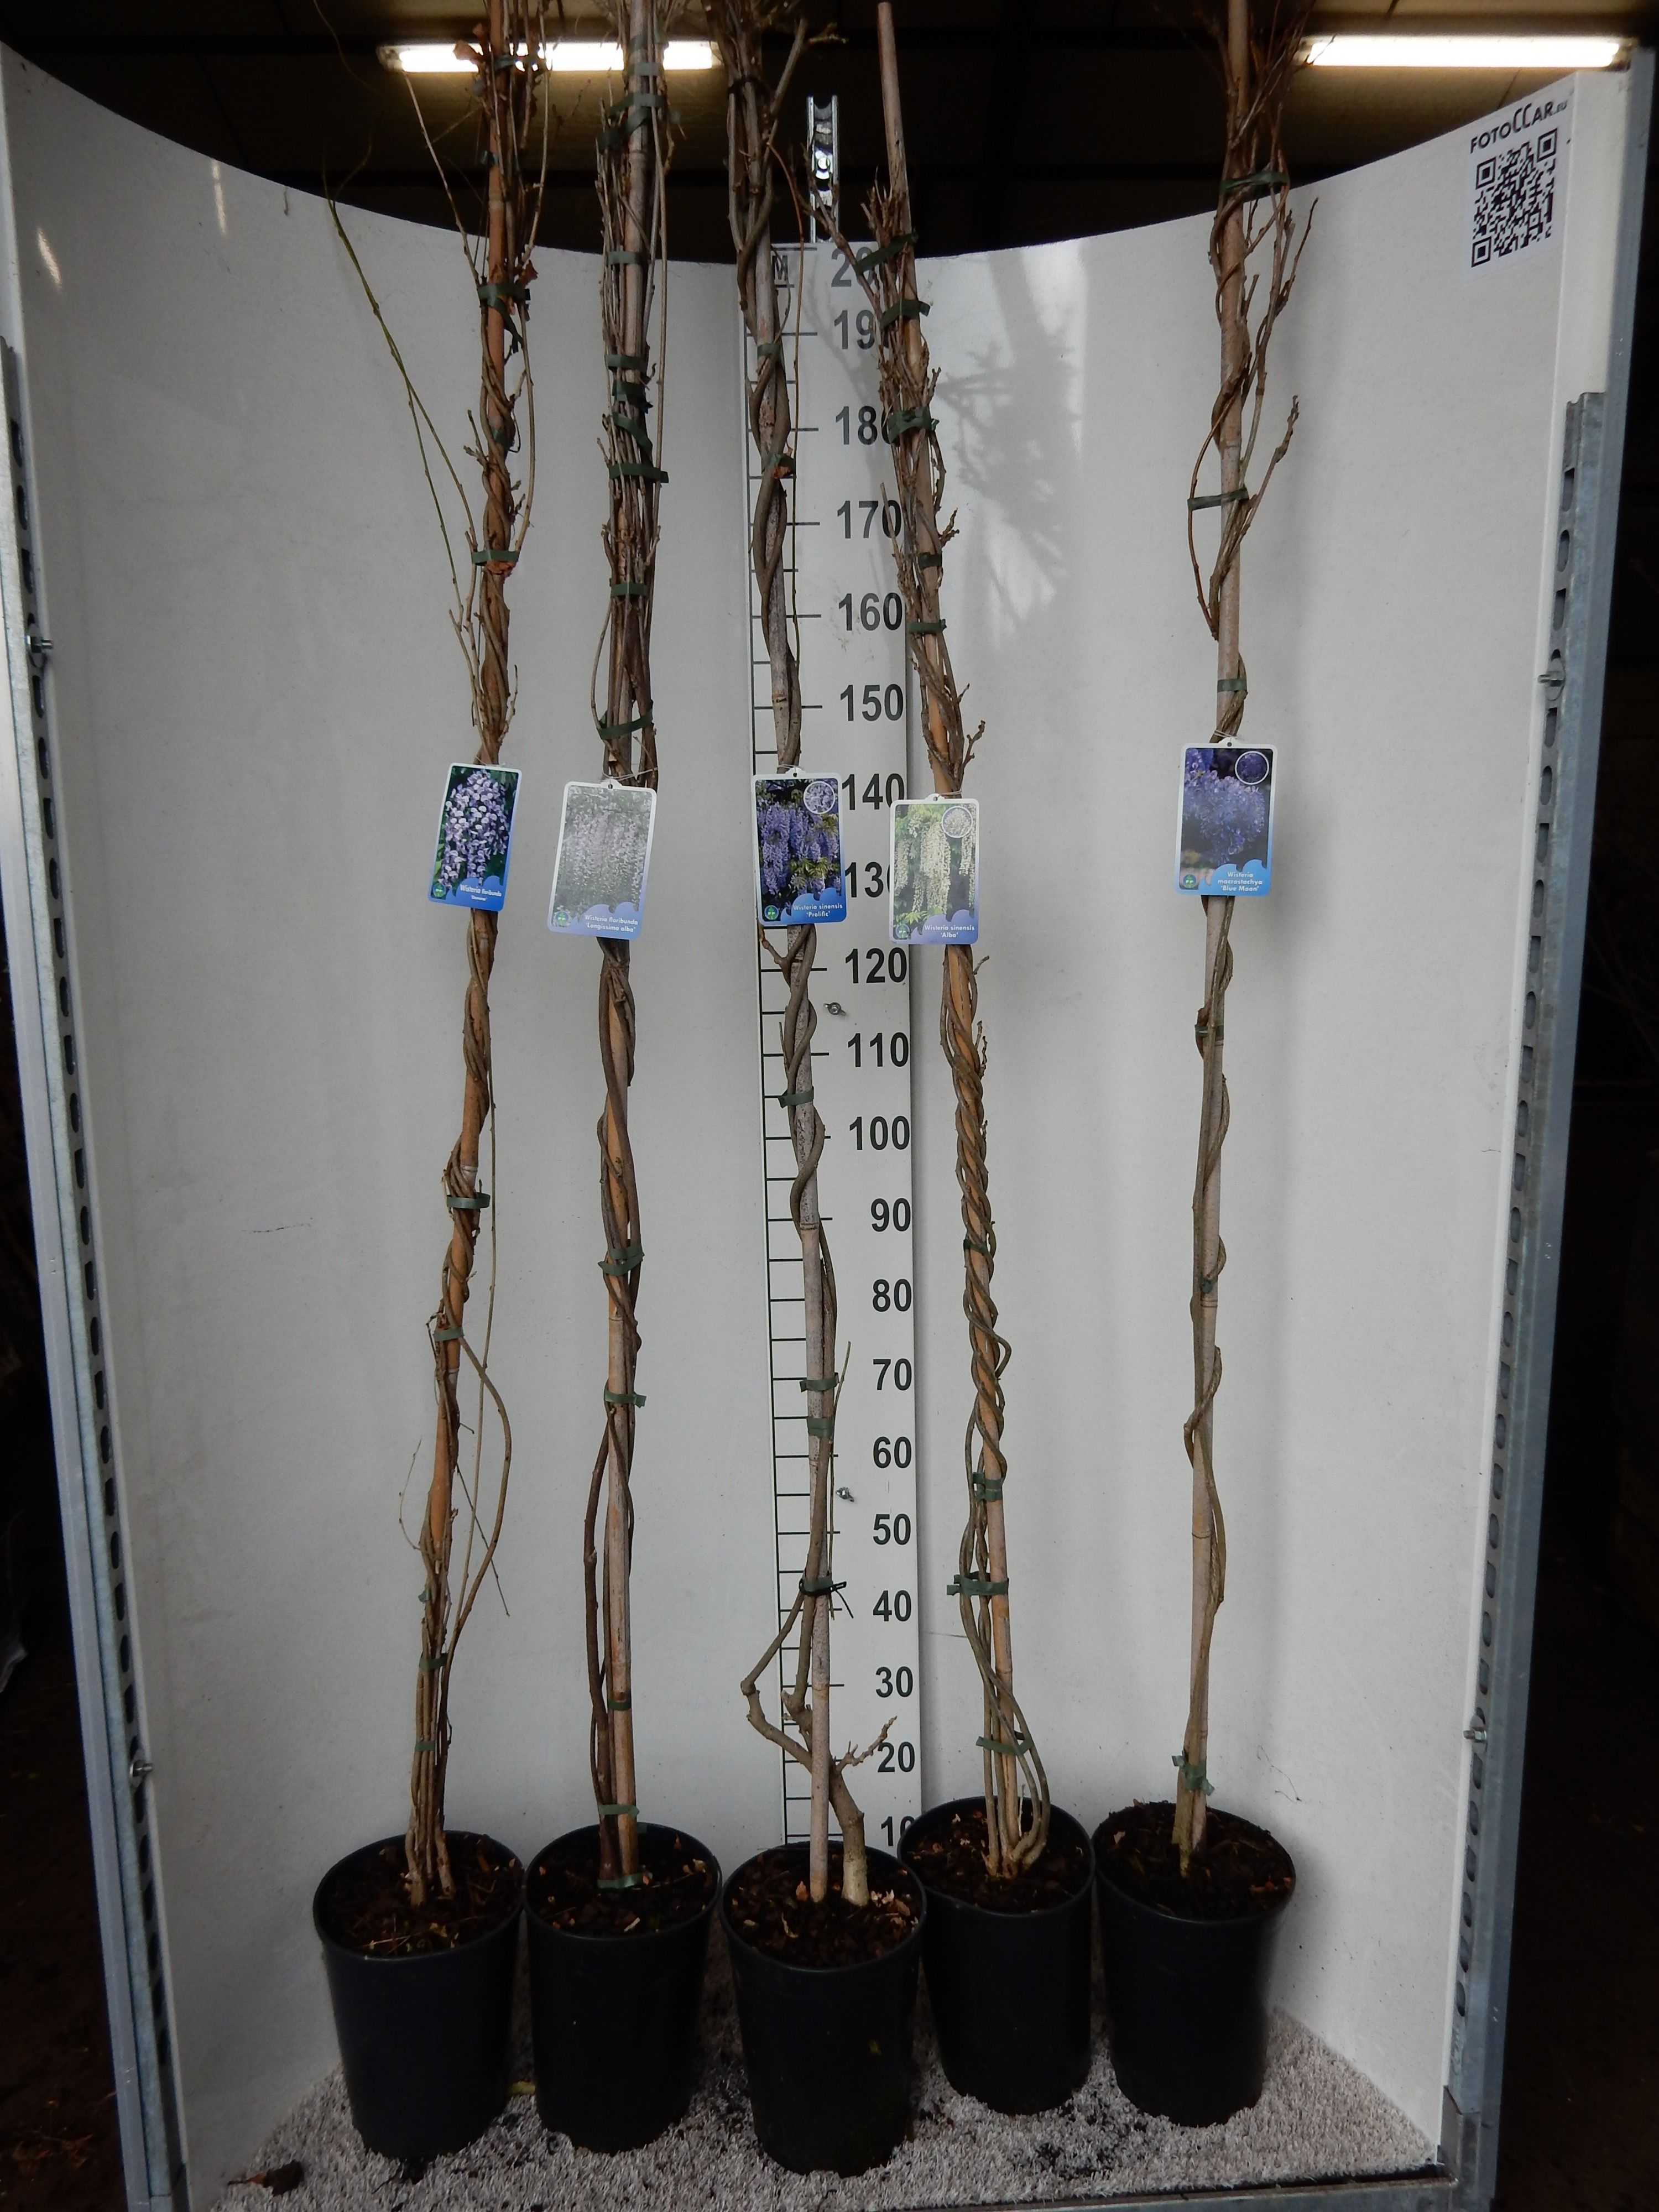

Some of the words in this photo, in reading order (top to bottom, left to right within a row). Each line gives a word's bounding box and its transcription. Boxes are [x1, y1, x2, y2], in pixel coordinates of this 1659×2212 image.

[834, 310, 890, 349] 19
[837, 500, 901, 539] 170
[838, 592, 902, 631] 160
[840, 684, 904, 722] 150
[842, 773, 904, 810] 140
[845, 862, 890, 898] 13
[845, 947, 907, 984] 120
[848, 1032, 909, 1067] 110
[849, 1116, 910, 1150] 100
[870, 1198, 911, 1232] 90
[872, 1279, 912, 1312] 80
[873, 1358, 912, 1391] 70
[873, 1436, 912, 1469] 60
[873, 1514, 911, 1545] 50
[873, 1590, 912, 1621] 40
[875, 1666, 914, 1698] 30
[878, 1741, 915, 1772] 20
